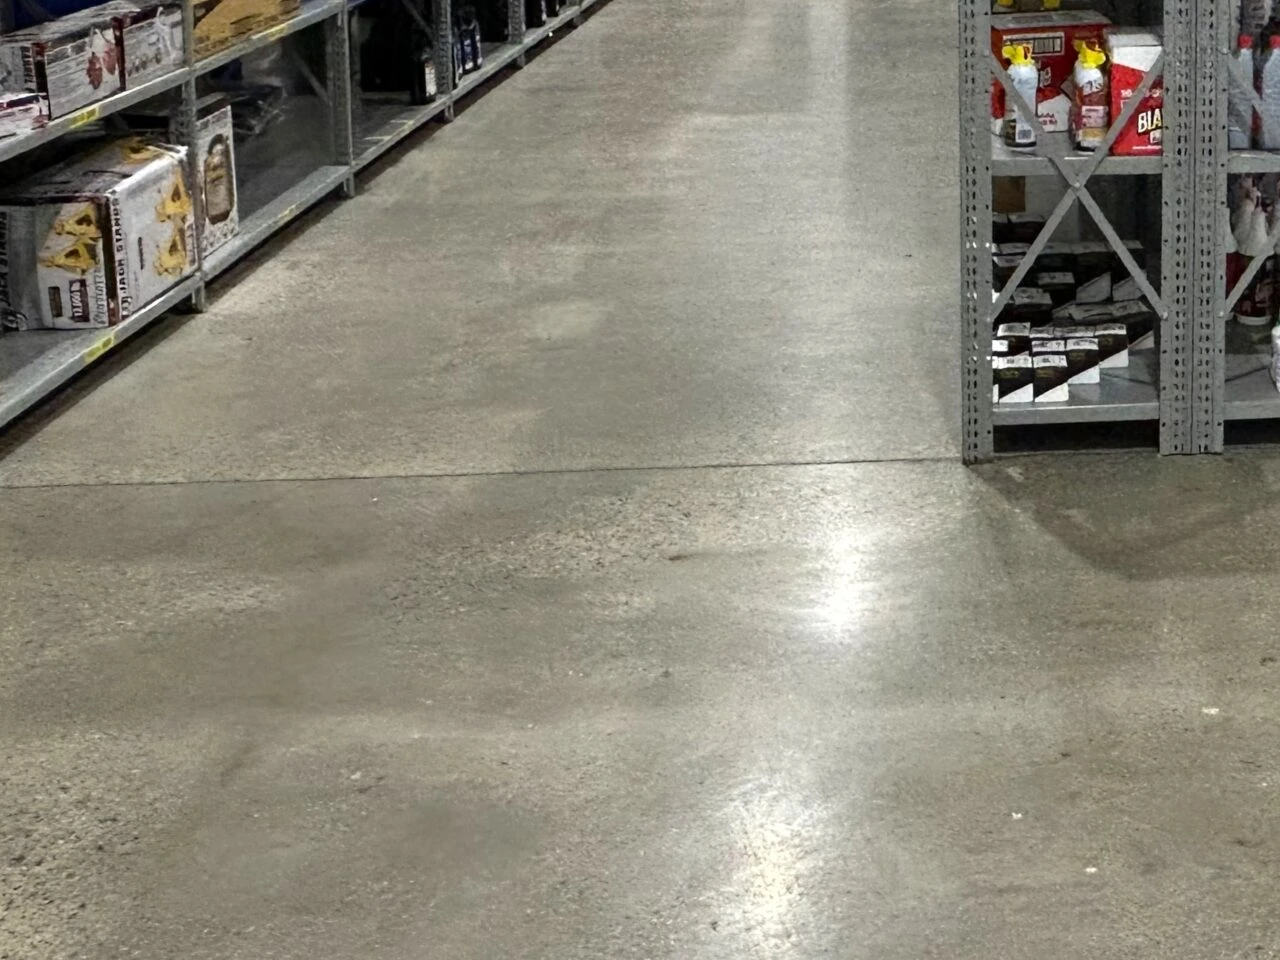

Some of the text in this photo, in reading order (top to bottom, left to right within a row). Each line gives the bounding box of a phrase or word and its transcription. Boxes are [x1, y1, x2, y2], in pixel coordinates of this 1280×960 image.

[1137, 108, 1162, 134] BLA
[111, 197, 123, 253] STANDS
[117, 258, 128, 293] JACK
